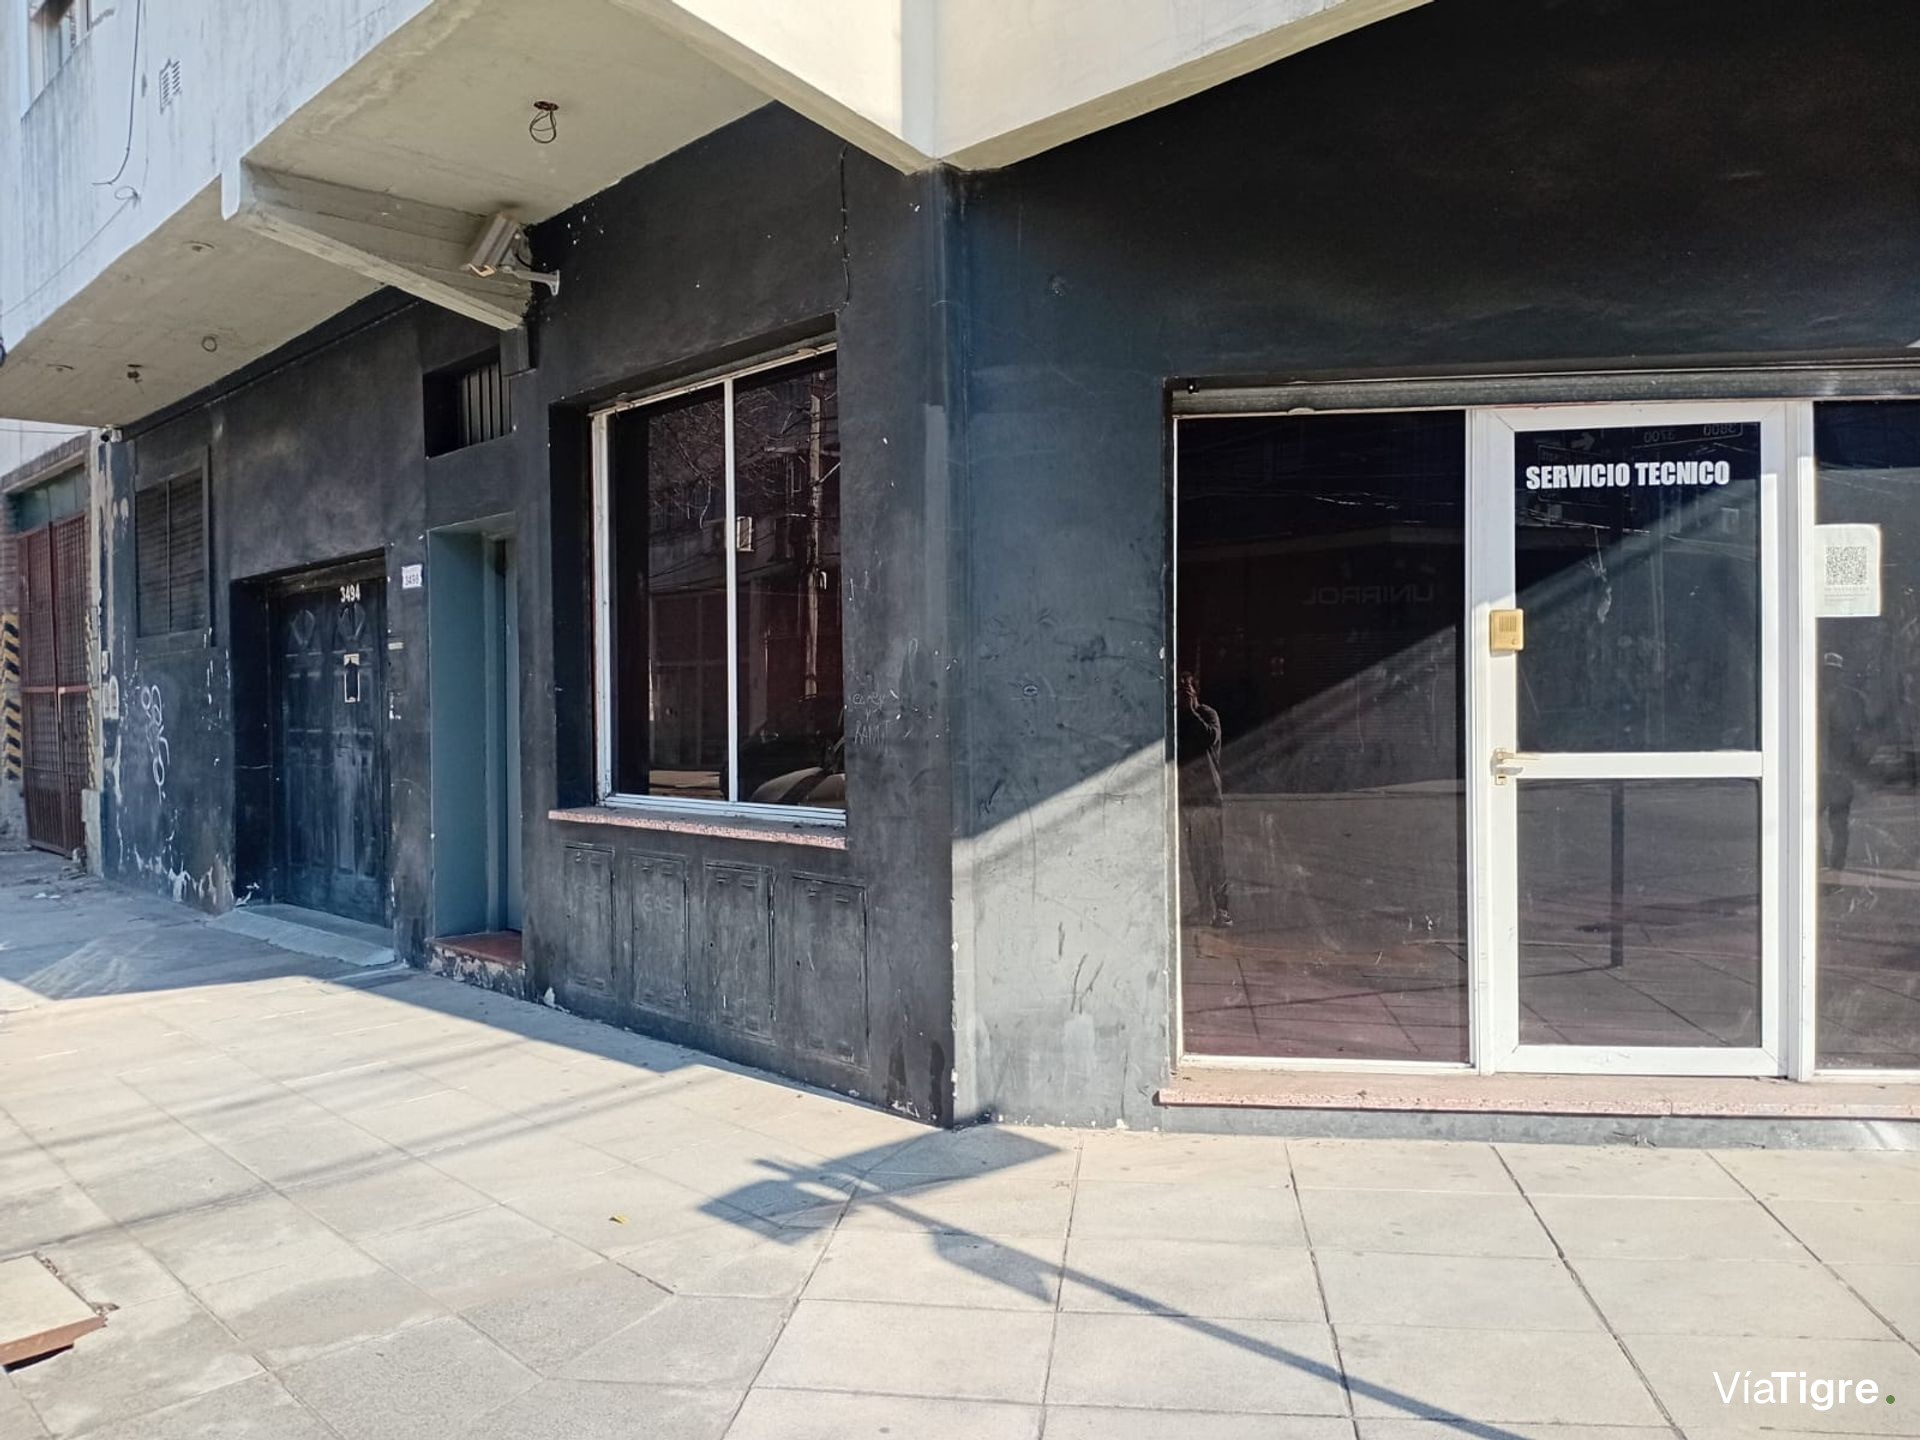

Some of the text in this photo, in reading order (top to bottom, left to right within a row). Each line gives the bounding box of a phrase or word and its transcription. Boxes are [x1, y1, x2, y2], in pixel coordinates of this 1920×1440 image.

[1525, 460, 1730, 490] SERVICIO TECNICO
[340, 582, 361, 602] 3494
